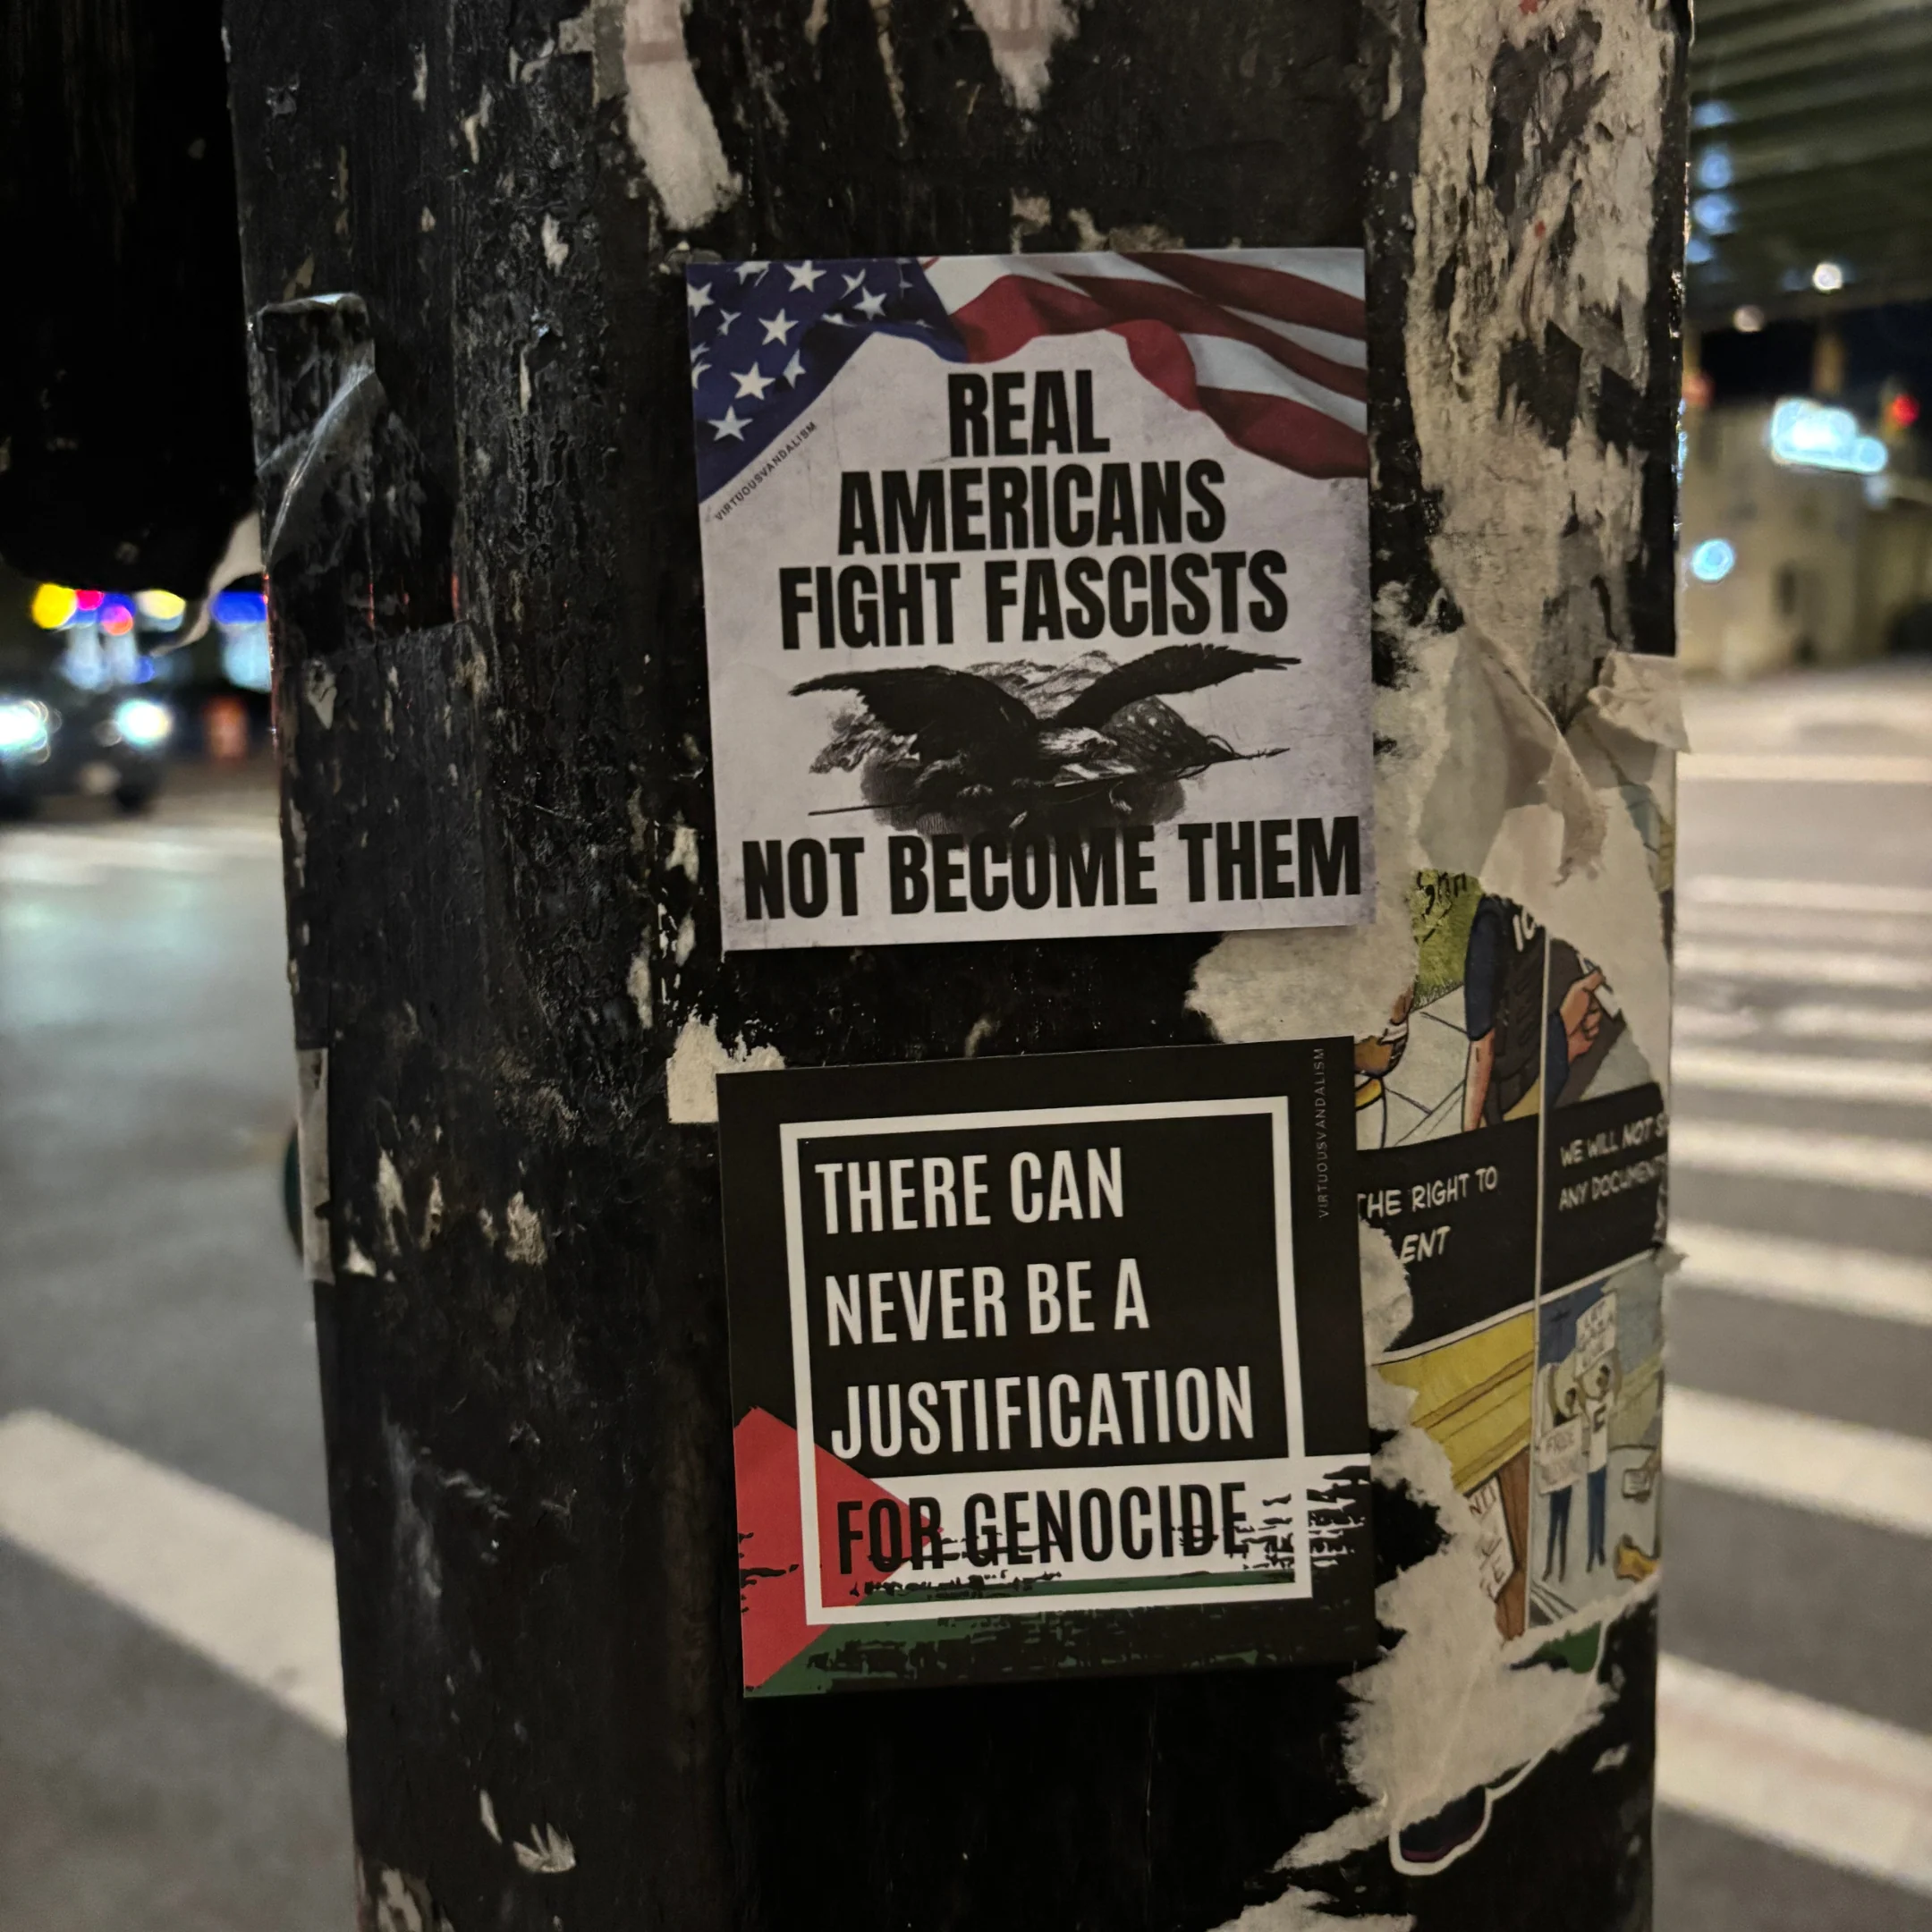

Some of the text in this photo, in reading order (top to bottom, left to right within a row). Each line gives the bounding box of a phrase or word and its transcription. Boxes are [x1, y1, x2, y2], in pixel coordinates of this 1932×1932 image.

[948, 369, 1110, 457] REAL
[715, 421, 817, 521] VIRTUOUSVANDALISM
[837, 459, 1225, 555] AMERICANS
[779, 549, 1288, 649] FIGHT FASCISTS
[742, 816, 1360, 919] NOT BECOME THEM
[1313, 1047, 1330, 1219] VIRTUOUSVANDALISM
[1560, 1139, 1583, 1167] WE
[1587, 1131, 1619, 1158] WILL
[1622, 1116, 1654, 1148] NOT
[816, 1148, 1123, 1234] THERE CAN
[1411, 1173, 1470, 1212] RIGHT
[1475, 1166, 1497, 1192] TO
[1558, 1181, 1589, 1212] ANY
[825, 1258, 1149, 1346] NEVER BE A
[831, 1366, 1254, 1459] JUSTIFICATION
[836, 1482, 1247, 1574] FOR GENOCIDE
